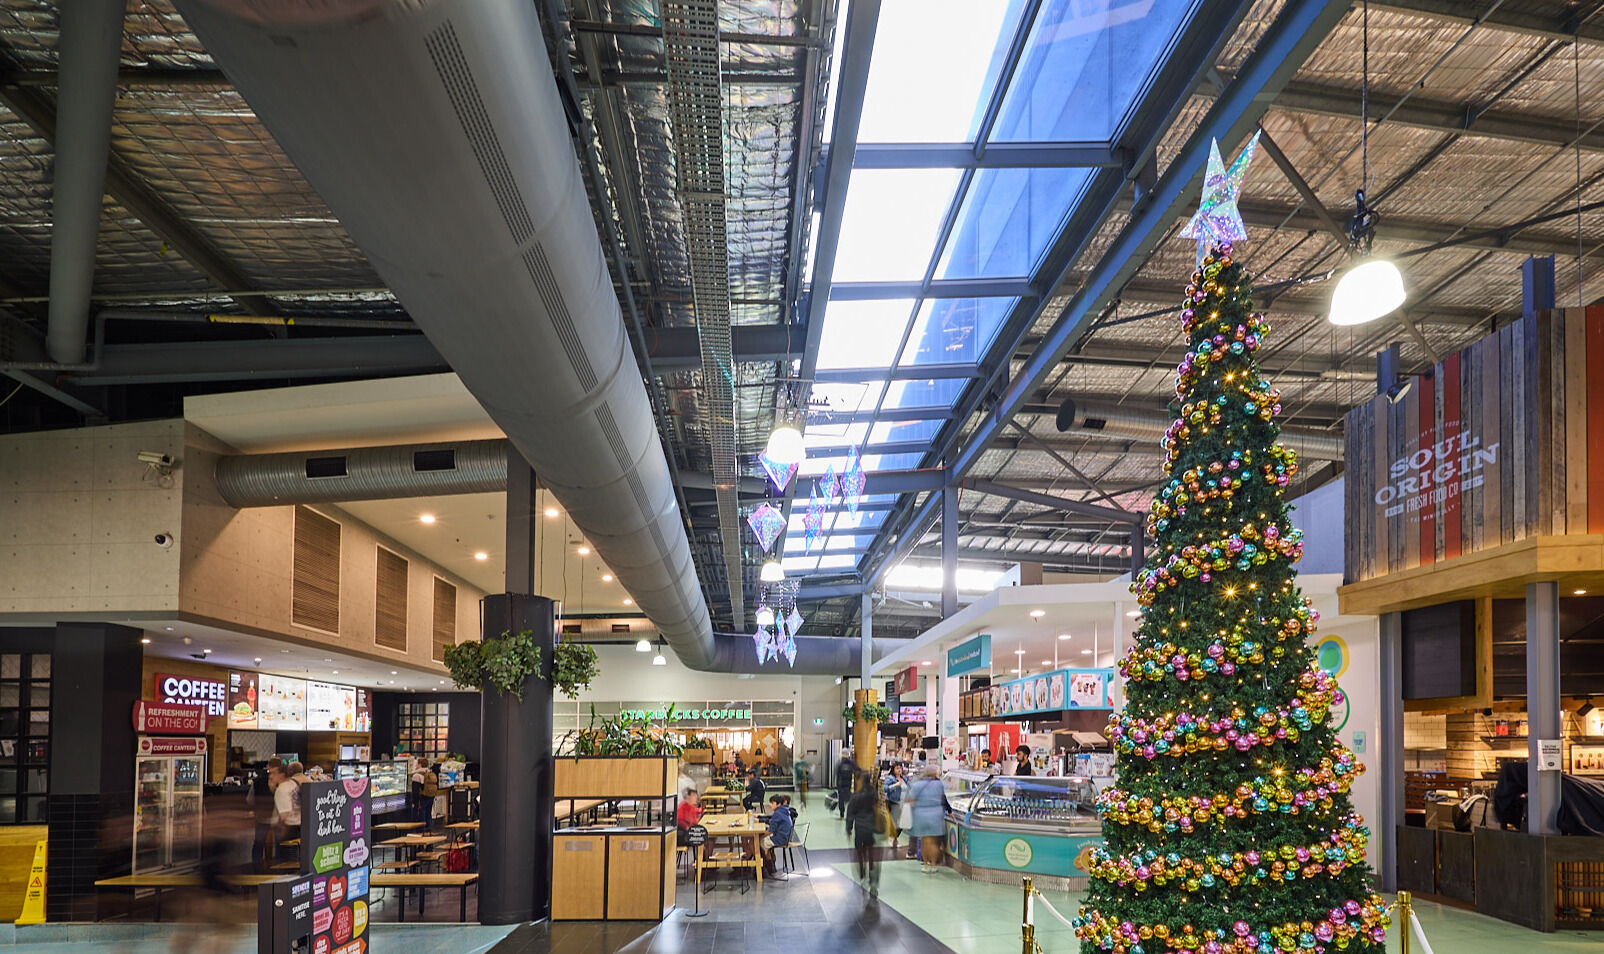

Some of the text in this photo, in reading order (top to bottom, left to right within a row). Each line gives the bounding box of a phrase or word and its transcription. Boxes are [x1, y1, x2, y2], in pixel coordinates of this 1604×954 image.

[1390, 430, 1479, 479] SOUL
[1374, 442, 1499, 505] ORIGIN
[1406, 493, 1428, 513] FRESH
[1429, 486, 1448, 506] FOOD
[164, 677, 226, 700] COFFEE
[148, 708, 199, 718] REFRESHMENT
[622, 709, 751, 720] STARBCKS COFFEE
[147, 716, 198, 729] ON THE GO!
[153, 744, 173, 752] COFFEE
[173, 744, 196, 752] CANTEEN
